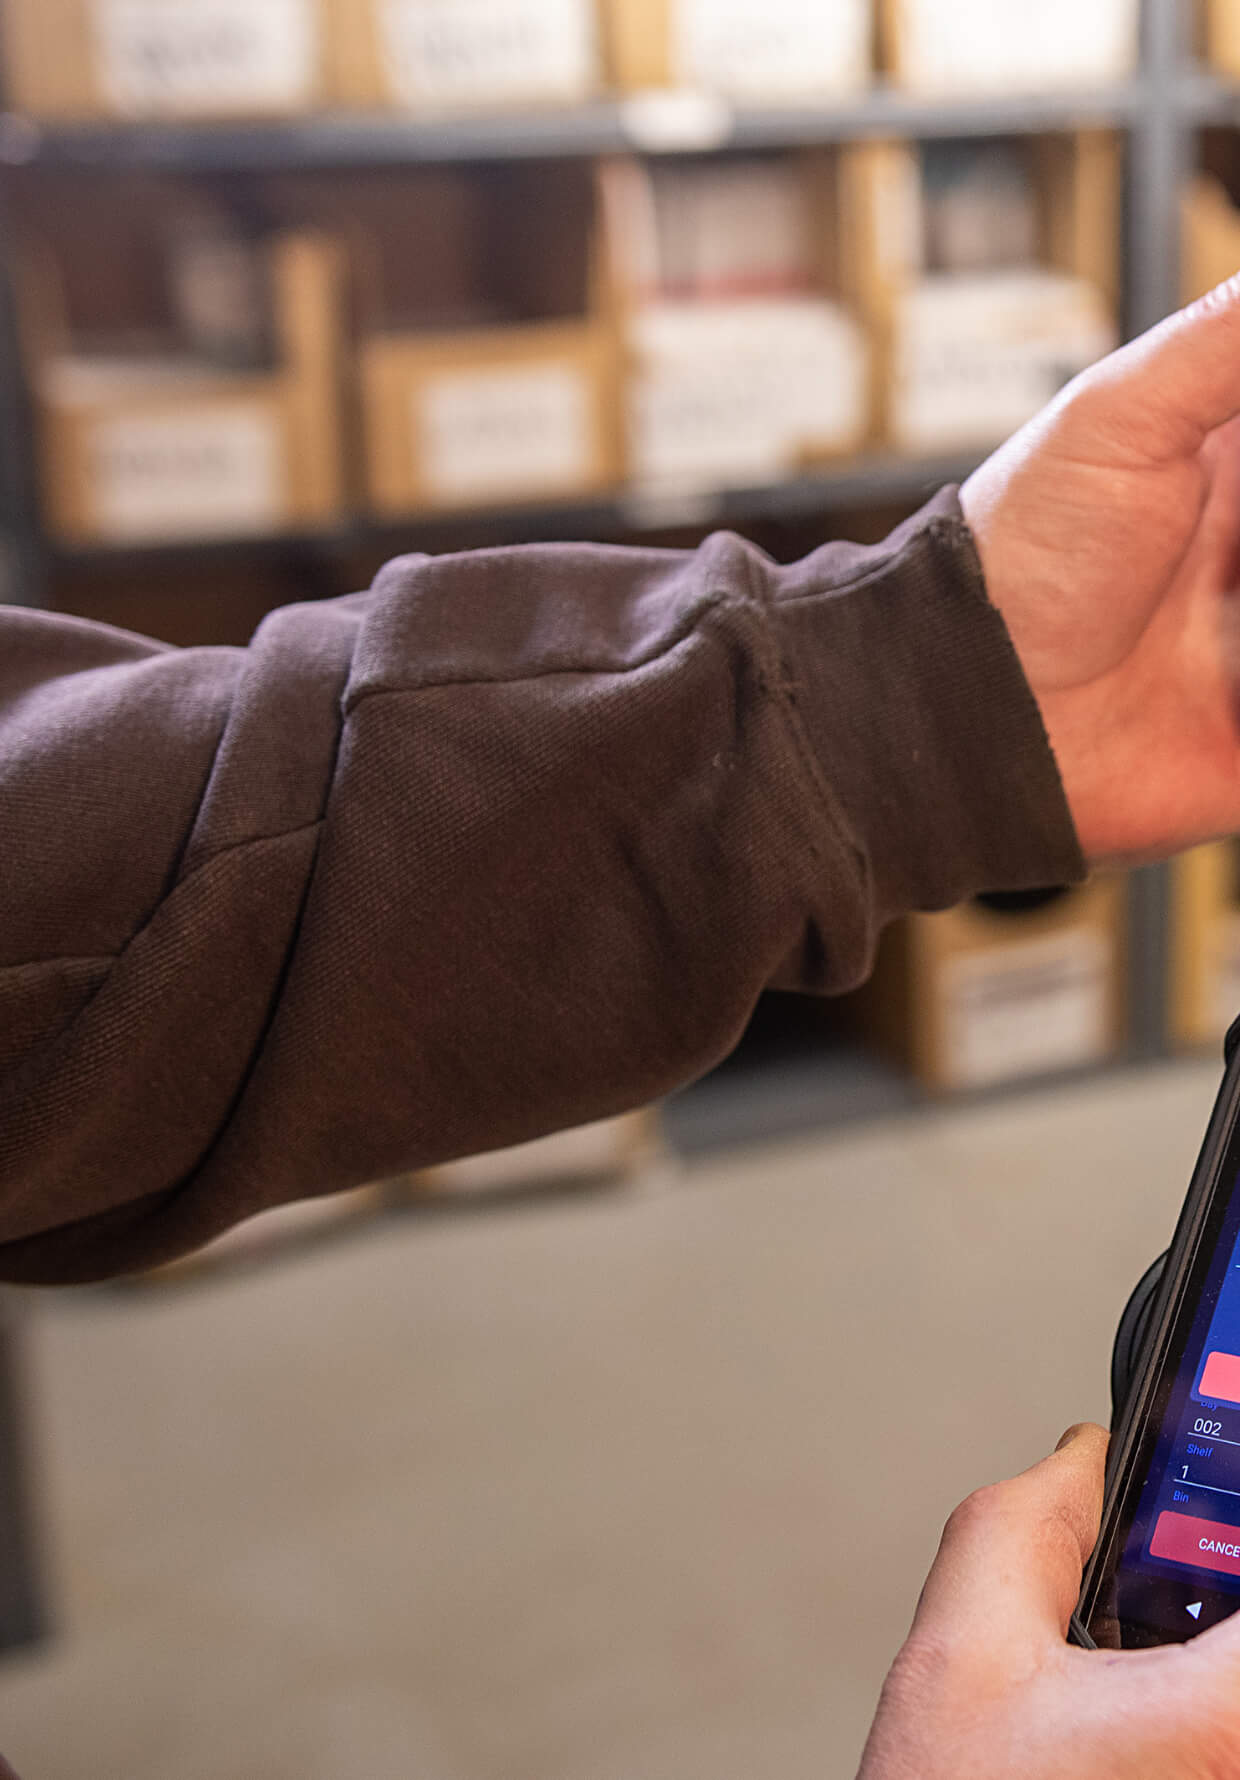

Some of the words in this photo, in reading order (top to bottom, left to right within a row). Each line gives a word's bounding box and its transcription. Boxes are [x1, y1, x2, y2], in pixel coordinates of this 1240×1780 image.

[1193, 1418, 1222, 1436] 002
[1187, 1443, 1214, 1458] Shelf
[1181, 1465, 1189, 1479] 1
[1173, 1490, 1189, 1503] Bin
